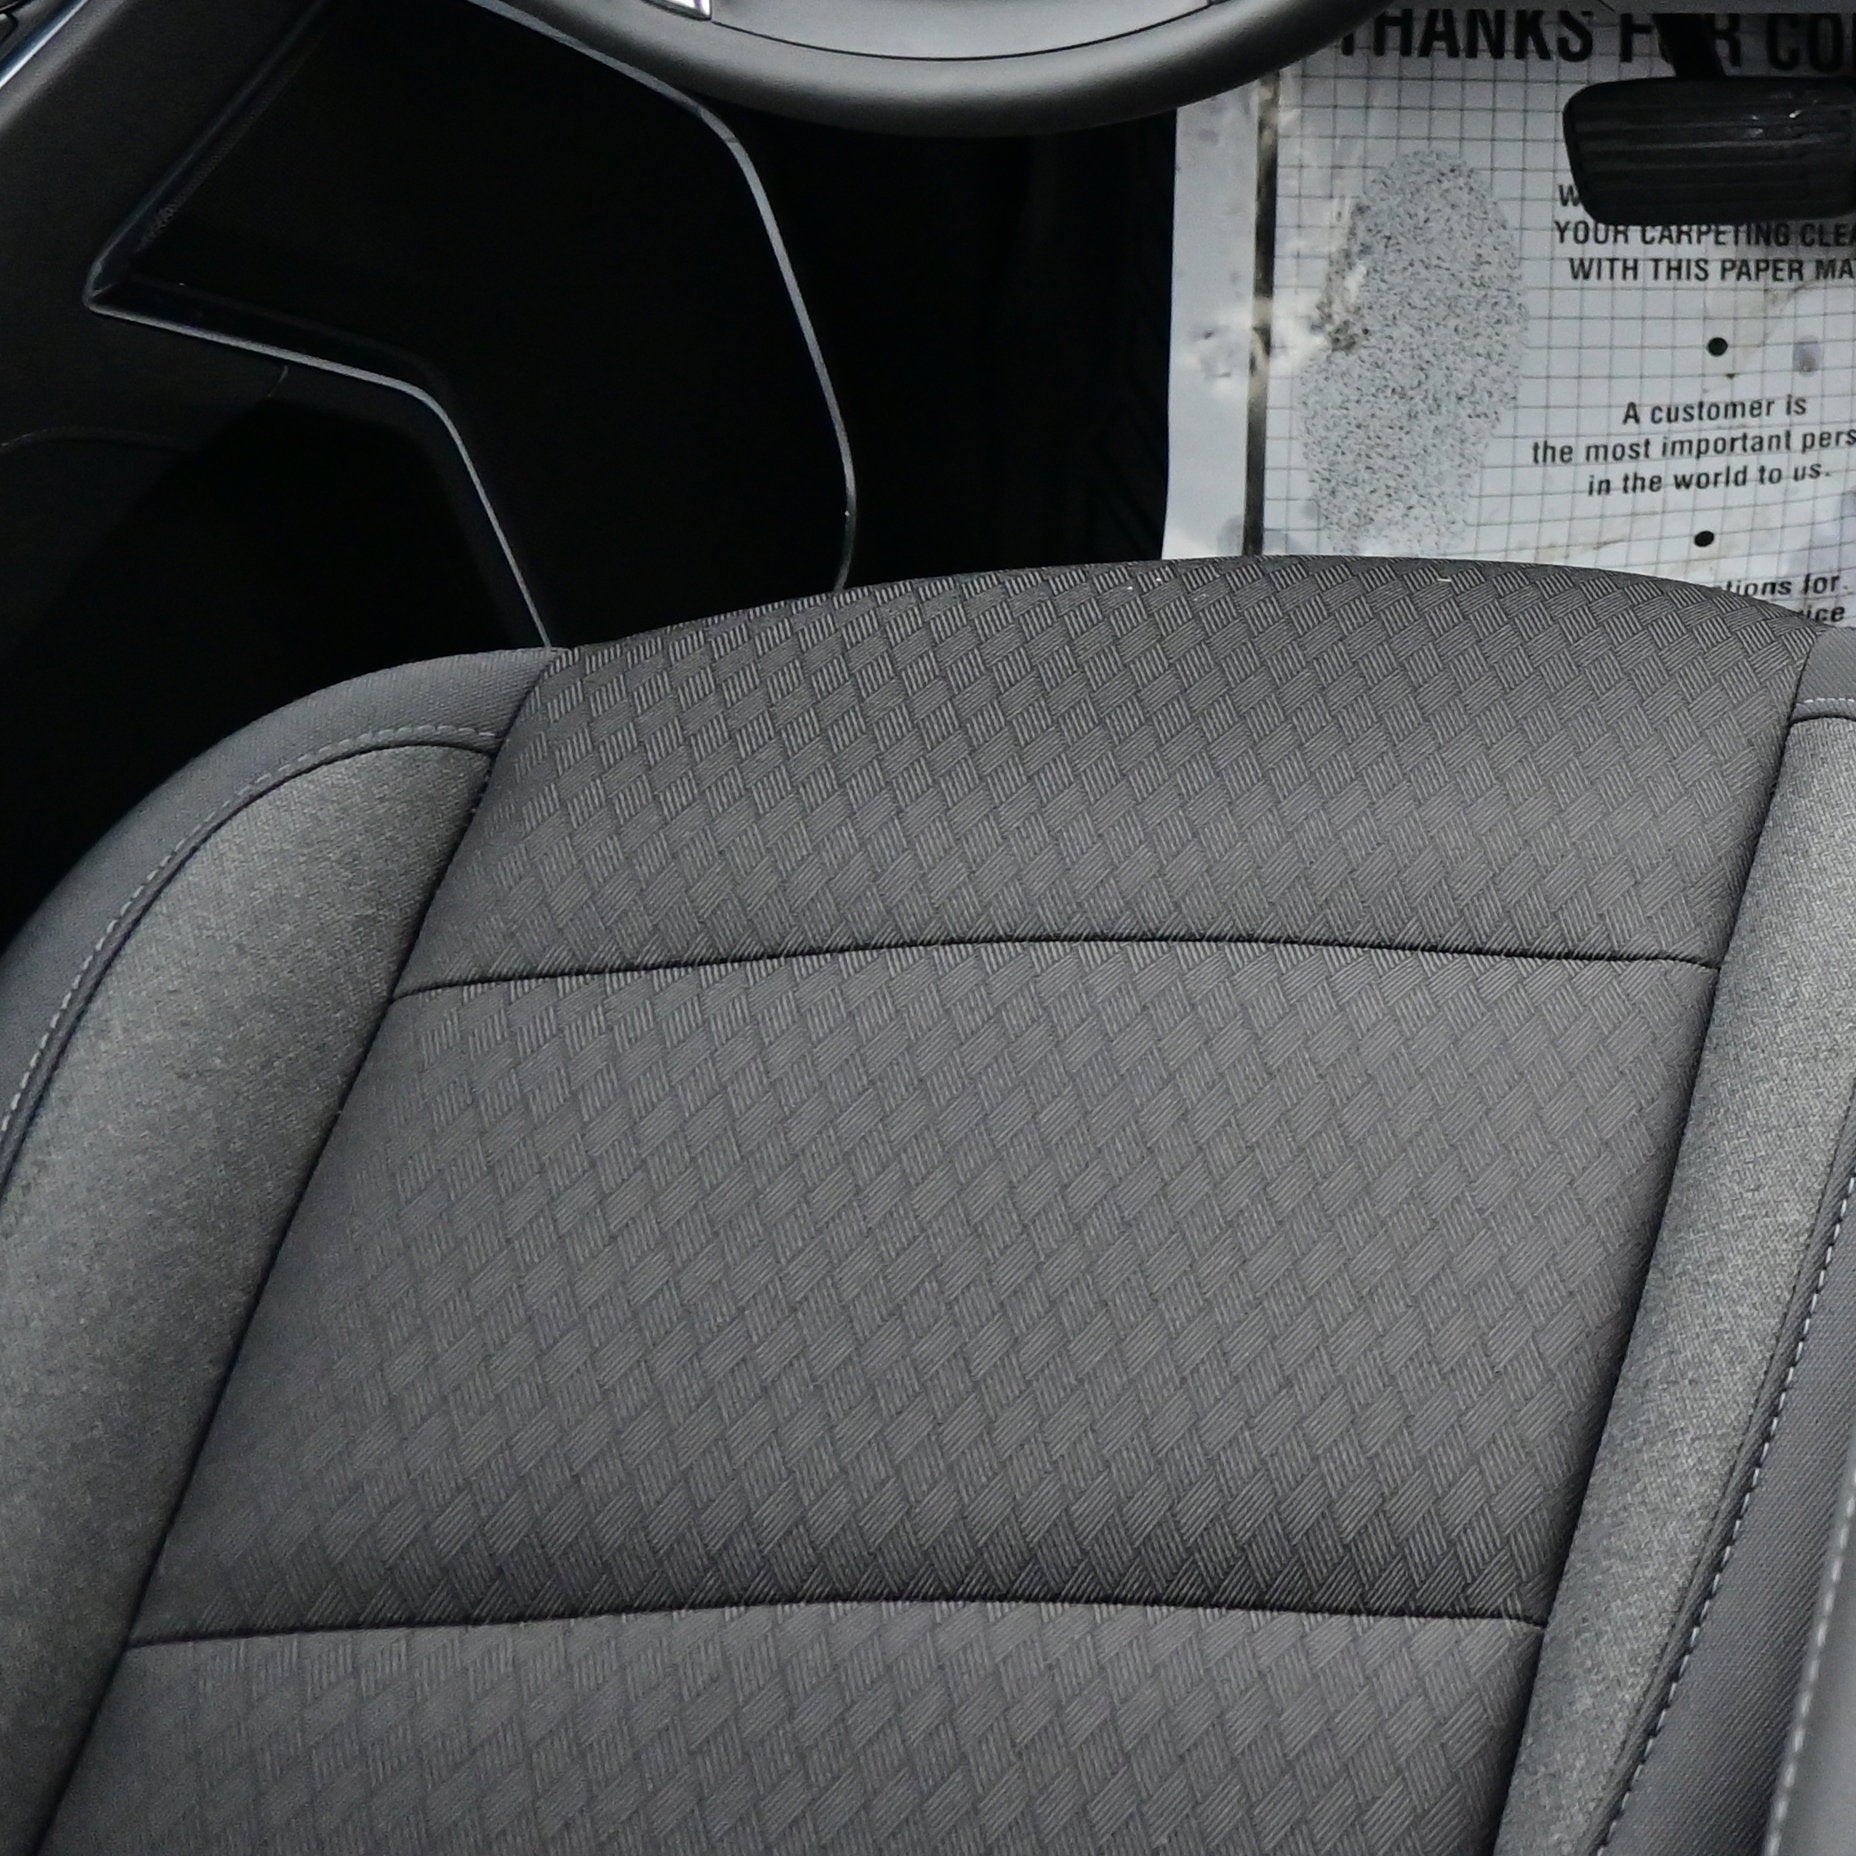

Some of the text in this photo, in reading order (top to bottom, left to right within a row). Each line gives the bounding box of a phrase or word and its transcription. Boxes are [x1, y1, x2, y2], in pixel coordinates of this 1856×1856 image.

[1619, 12, 1741, 67] FR
[1554, 221, 1629, 246] YOUR
[1640, 223, 1791, 246] CARPETING
[1568, 258, 1639, 282] WITH
[1650, 257, 1709, 282] THIS
[1720, 258, 1804, 283] PAPER
[1622, 394, 1807, 425] A customer is
[1532, 441, 1573, 465] the
[1585, 437, 1650, 463] most
[1661, 429, 1791, 463] important
[1587, 461, 1831, 496] in the world to us.
[1802, 572, 1841, 594] for
